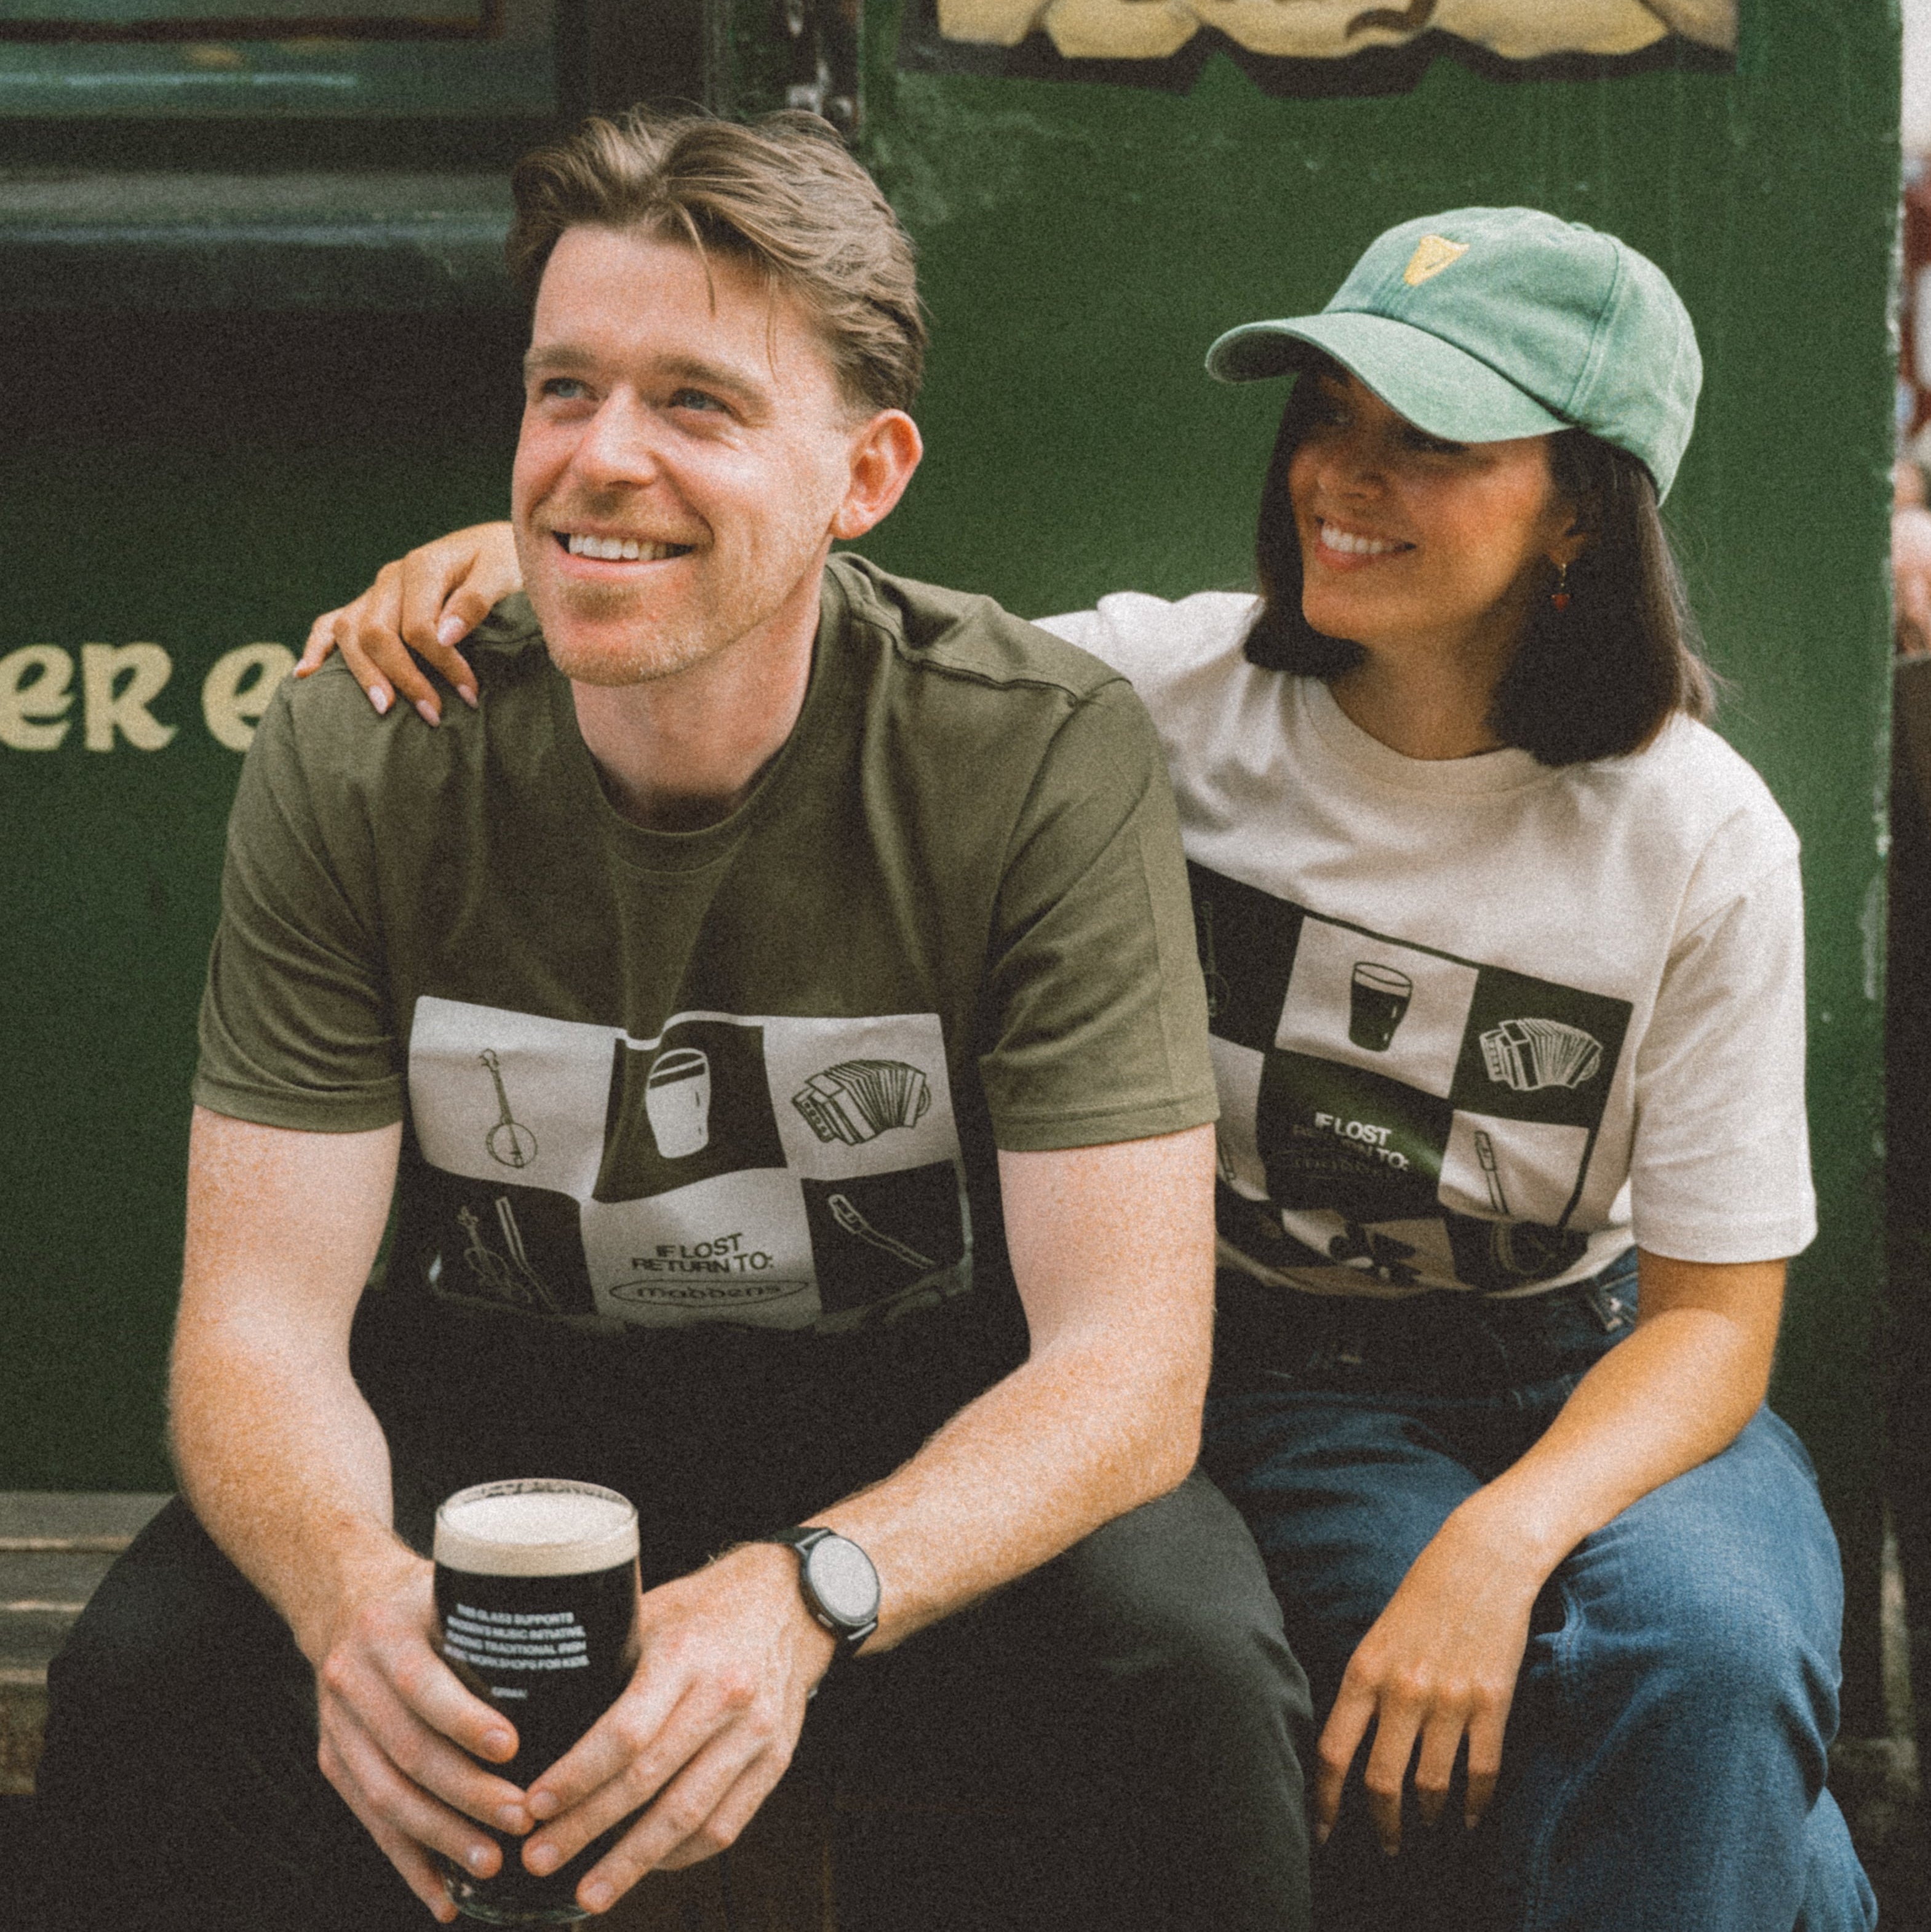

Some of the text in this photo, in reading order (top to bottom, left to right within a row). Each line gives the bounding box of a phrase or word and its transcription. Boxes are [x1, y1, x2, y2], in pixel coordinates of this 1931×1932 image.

[1314, 1111, 1392, 1147] IF LOST
[1292, 1124, 1410, 1172] RERN TO:
[655, 1232, 743, 1259] IF LOST
[631, 1251, 774, 1274] RETURN TO:
[514, 1612, 575, 1626] SUPPORTS
